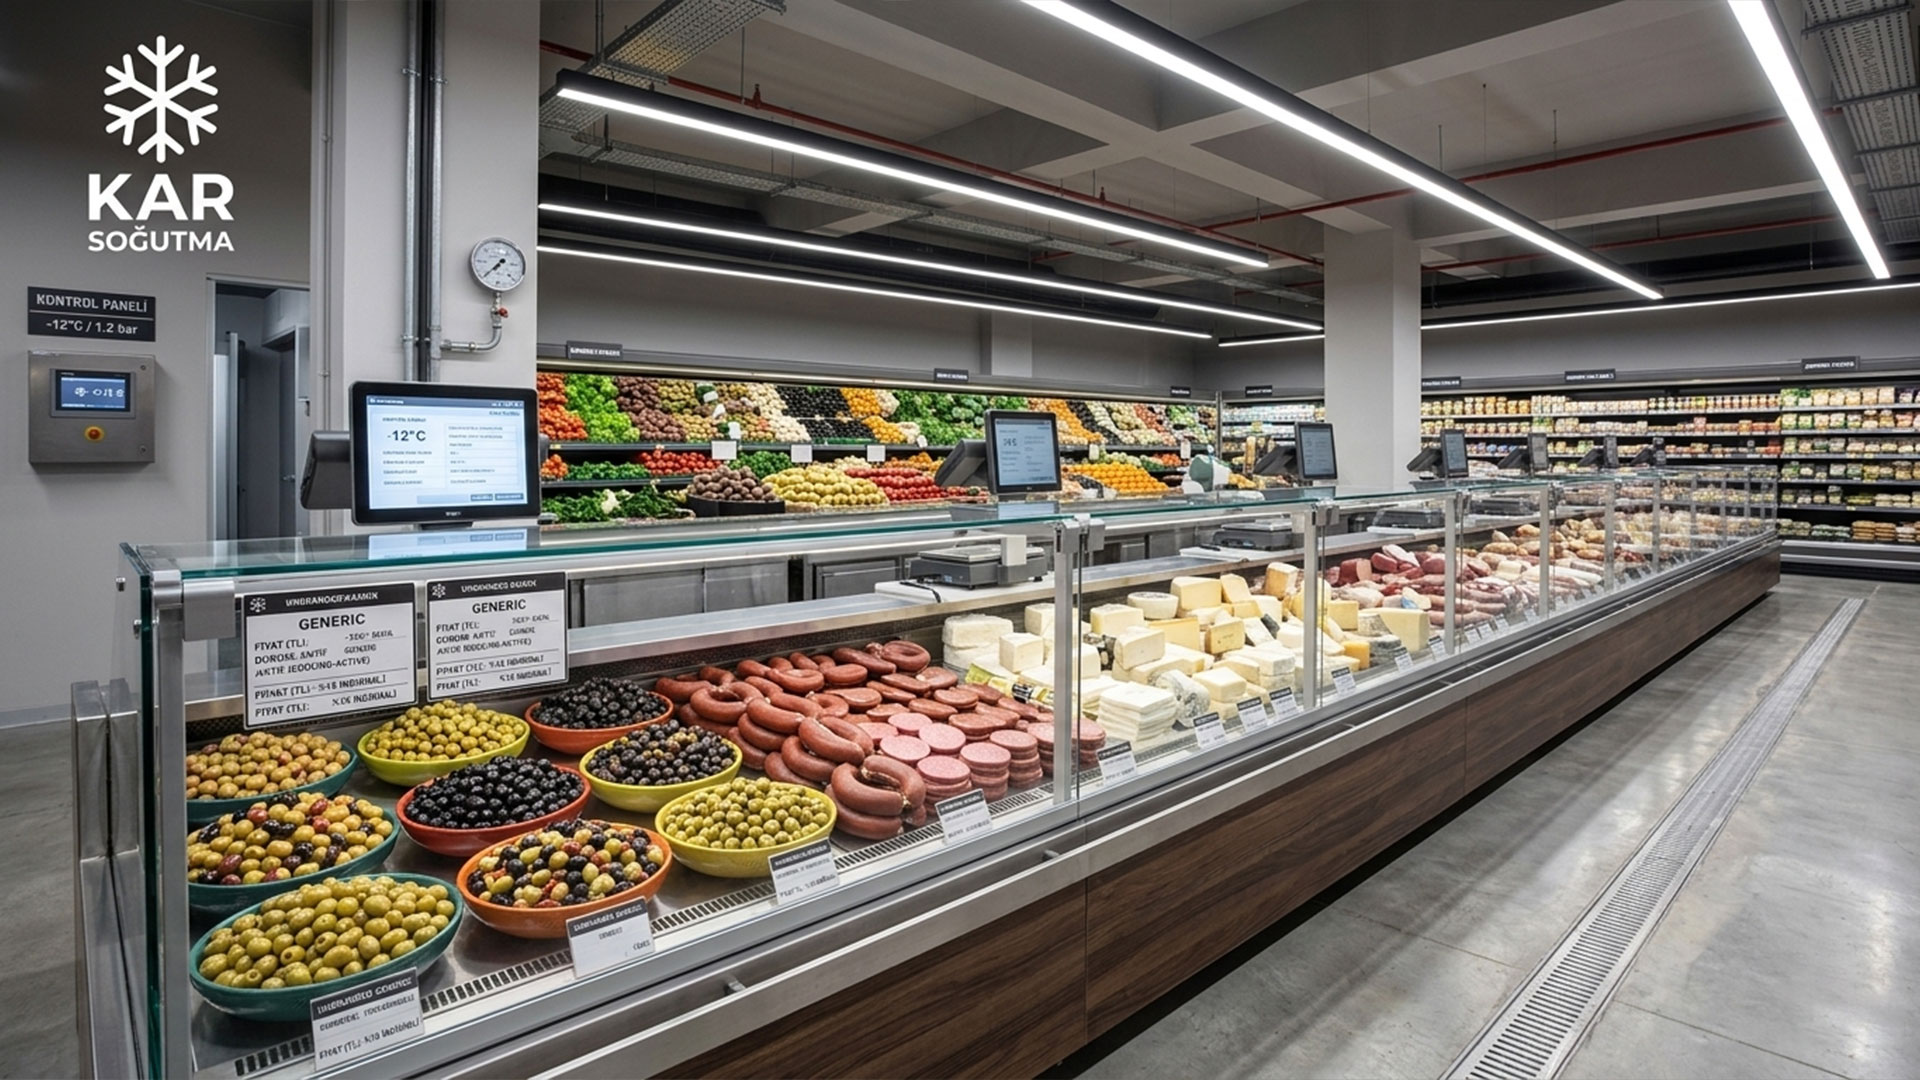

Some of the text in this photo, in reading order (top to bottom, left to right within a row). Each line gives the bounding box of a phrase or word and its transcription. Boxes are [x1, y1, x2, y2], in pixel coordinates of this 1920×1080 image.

[95, 323, 114, 333] 1.2
[118, 324, 138, 334] bar
[472, 598, 527, 615] GENERIC
[299, 613, 366, 631] GENERIC
